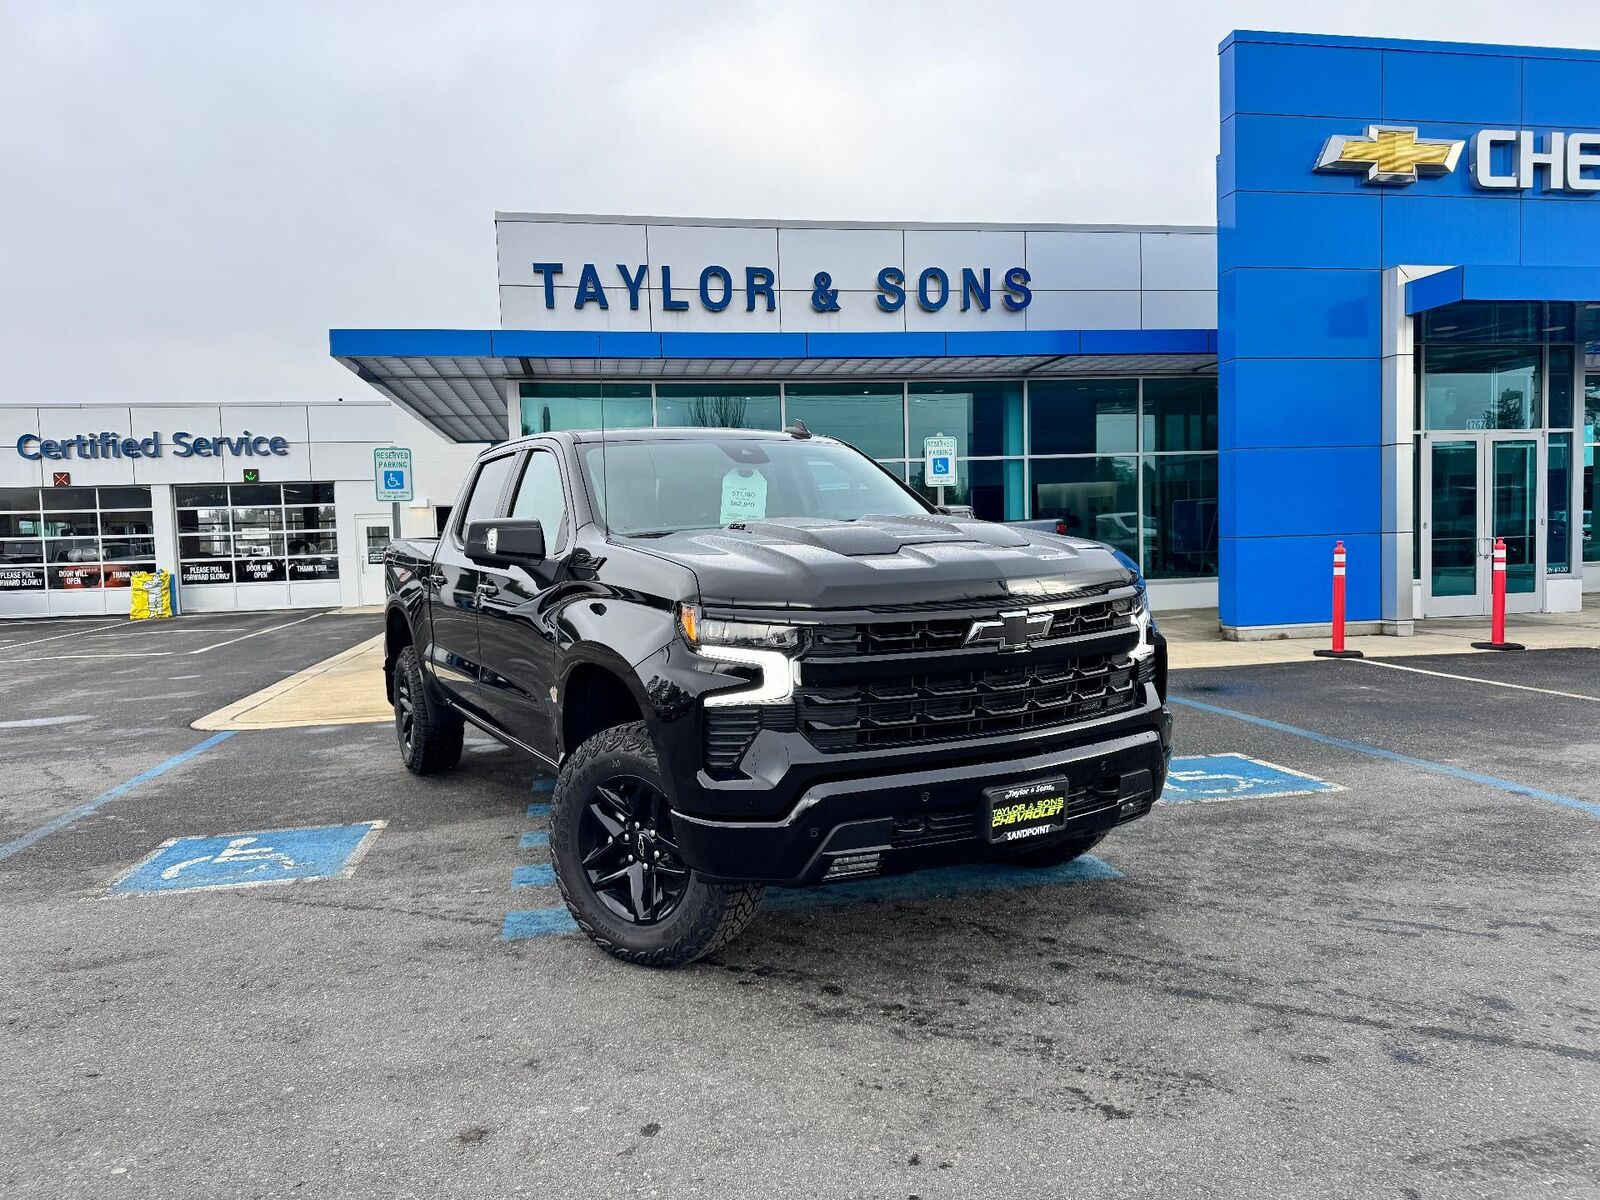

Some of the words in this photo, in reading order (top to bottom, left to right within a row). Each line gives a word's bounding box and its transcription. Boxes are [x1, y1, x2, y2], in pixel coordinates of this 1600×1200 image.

[1471, 129, 1600, 191] CHE
[532, 262, 777, 312] TAYLOR
[811, 271, 842, 313] &
[875, 267, 1033, 313] SONS
[16, 431, 163, 460] Certified
[172, 430, 289, 458] Service
[376, 451, 409, 459] RESERVED
[378, 461, 408, 469] PARKING
[246, 564, 261, 572] DOOR
[74, 569, 88, 577] WILL
[183, 573, 209, 581] FORWARD
[209, 572, 230, 580] SLOWLY
[253, 571, 268, 579] OPEN
[21, 578, 42, 586] SLOWLY
[66, 577, 81, 585] OPEN
[1005, 788, 1029, 799] Taylor
[992, 803, 1026, 818] TAYLOR
[1028, 802, 1034, 811] &
[1037, 797, 1064, 808] SONS
[992, 806, 1064, 827] CHEVROLET
[1007, 824, 1051, 840] SANDPOINT
